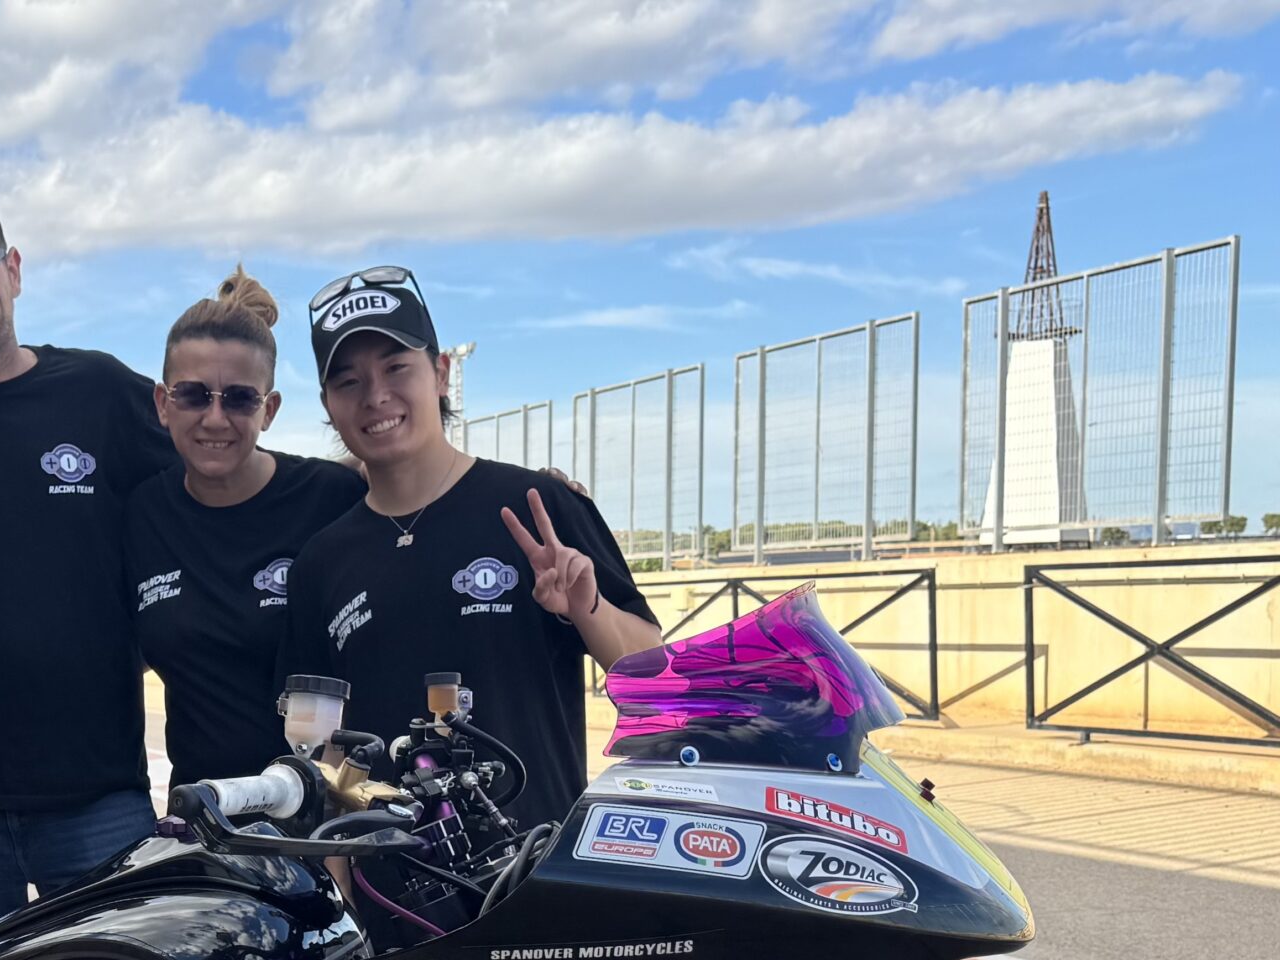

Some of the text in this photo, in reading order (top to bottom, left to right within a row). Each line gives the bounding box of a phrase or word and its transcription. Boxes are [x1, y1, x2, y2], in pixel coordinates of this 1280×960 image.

[331, 295, 388, 326] SHOEI
[76, 485, 95, 495] TEAM
[159, 587, 182, 600] TEAM
[351, 608, 373, 631] TEAM
[461, 603, 513, 616] RACING TEAM
[604, 815, 658, 841] BRL
[695, 821, 726, 832] SNACK
[776, 791, 900, 846] bitubo
[593, 842, 655, 856] EUROPE
[688, 833, 732, 854] PATA
[773, 878, 806, 901] ORIGINAL
[809, 897, 832, 908] PARTS
[843, 902, 891, 912] ACCESSORIES
[490, 940, 694, 960] SPANOVER MOTORCYCLES
